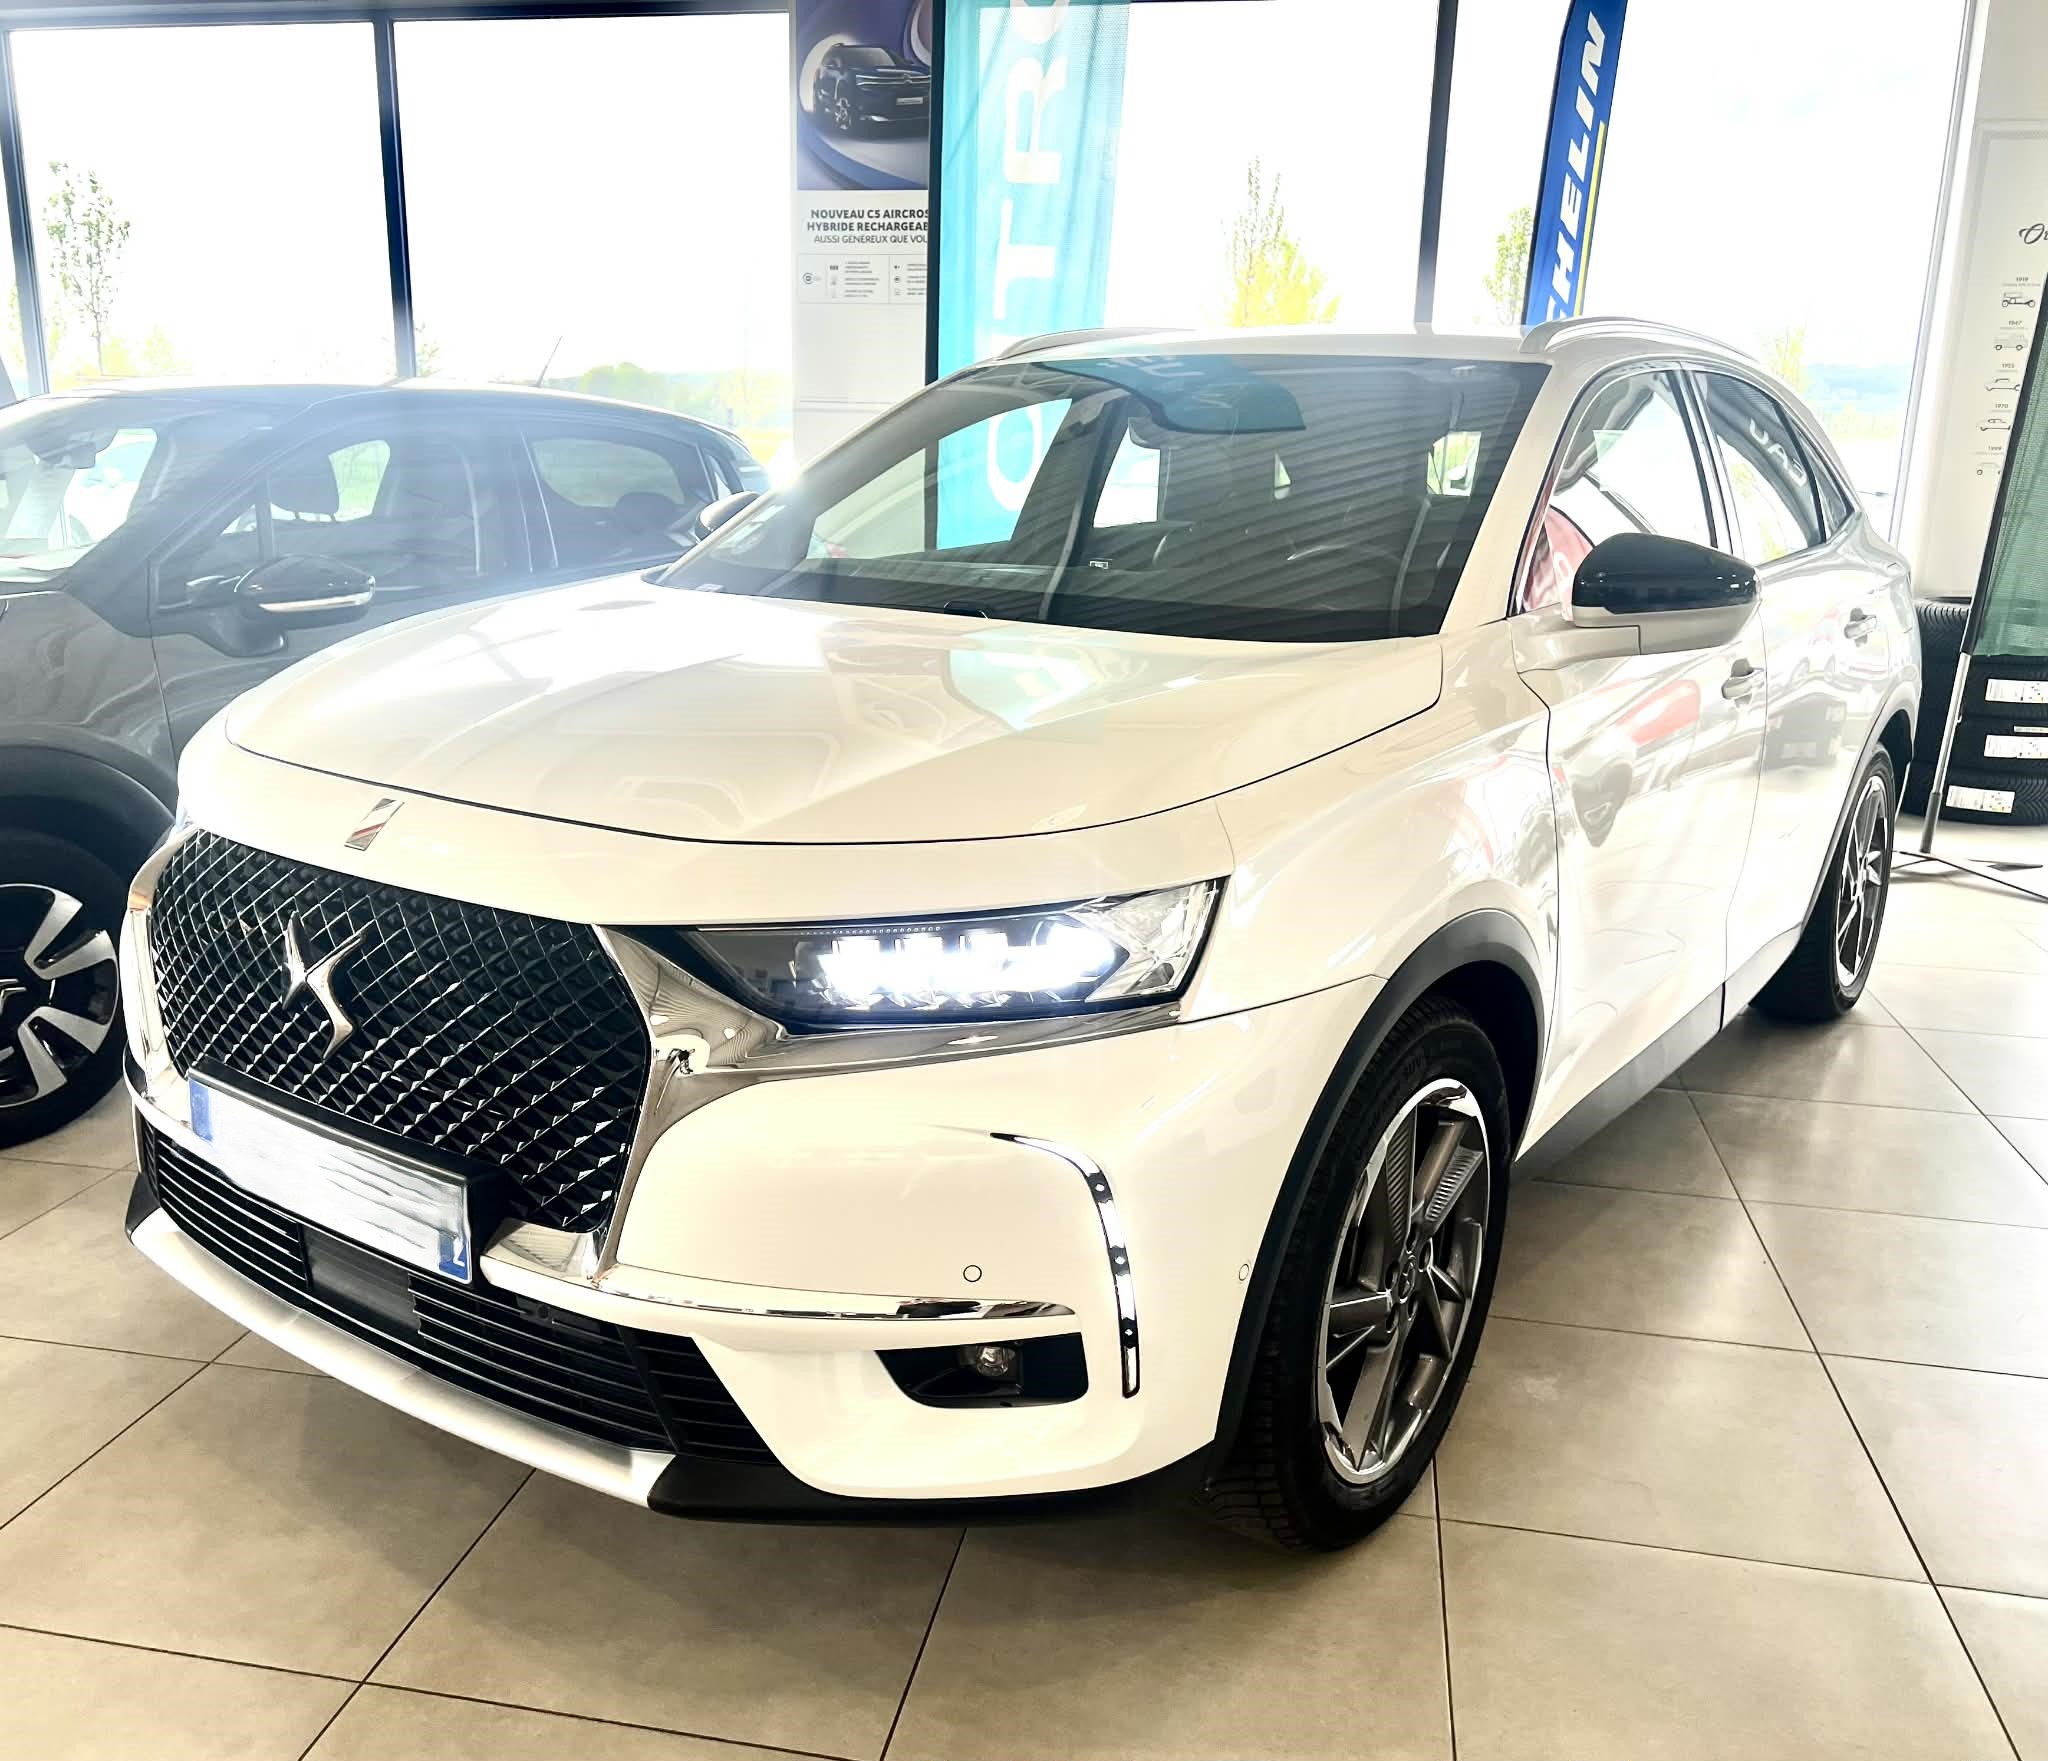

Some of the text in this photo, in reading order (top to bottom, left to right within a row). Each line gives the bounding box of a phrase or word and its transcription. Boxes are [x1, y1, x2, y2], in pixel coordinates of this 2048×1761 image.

[811, 209, 865, 219] NOUVEAU
[867, 209, 881, 219] C5
[807, 221, 855, 231] HYBRIDE
[814, 234, 840, 244] AUSSI
[889, 234, 909, 244] QUE
